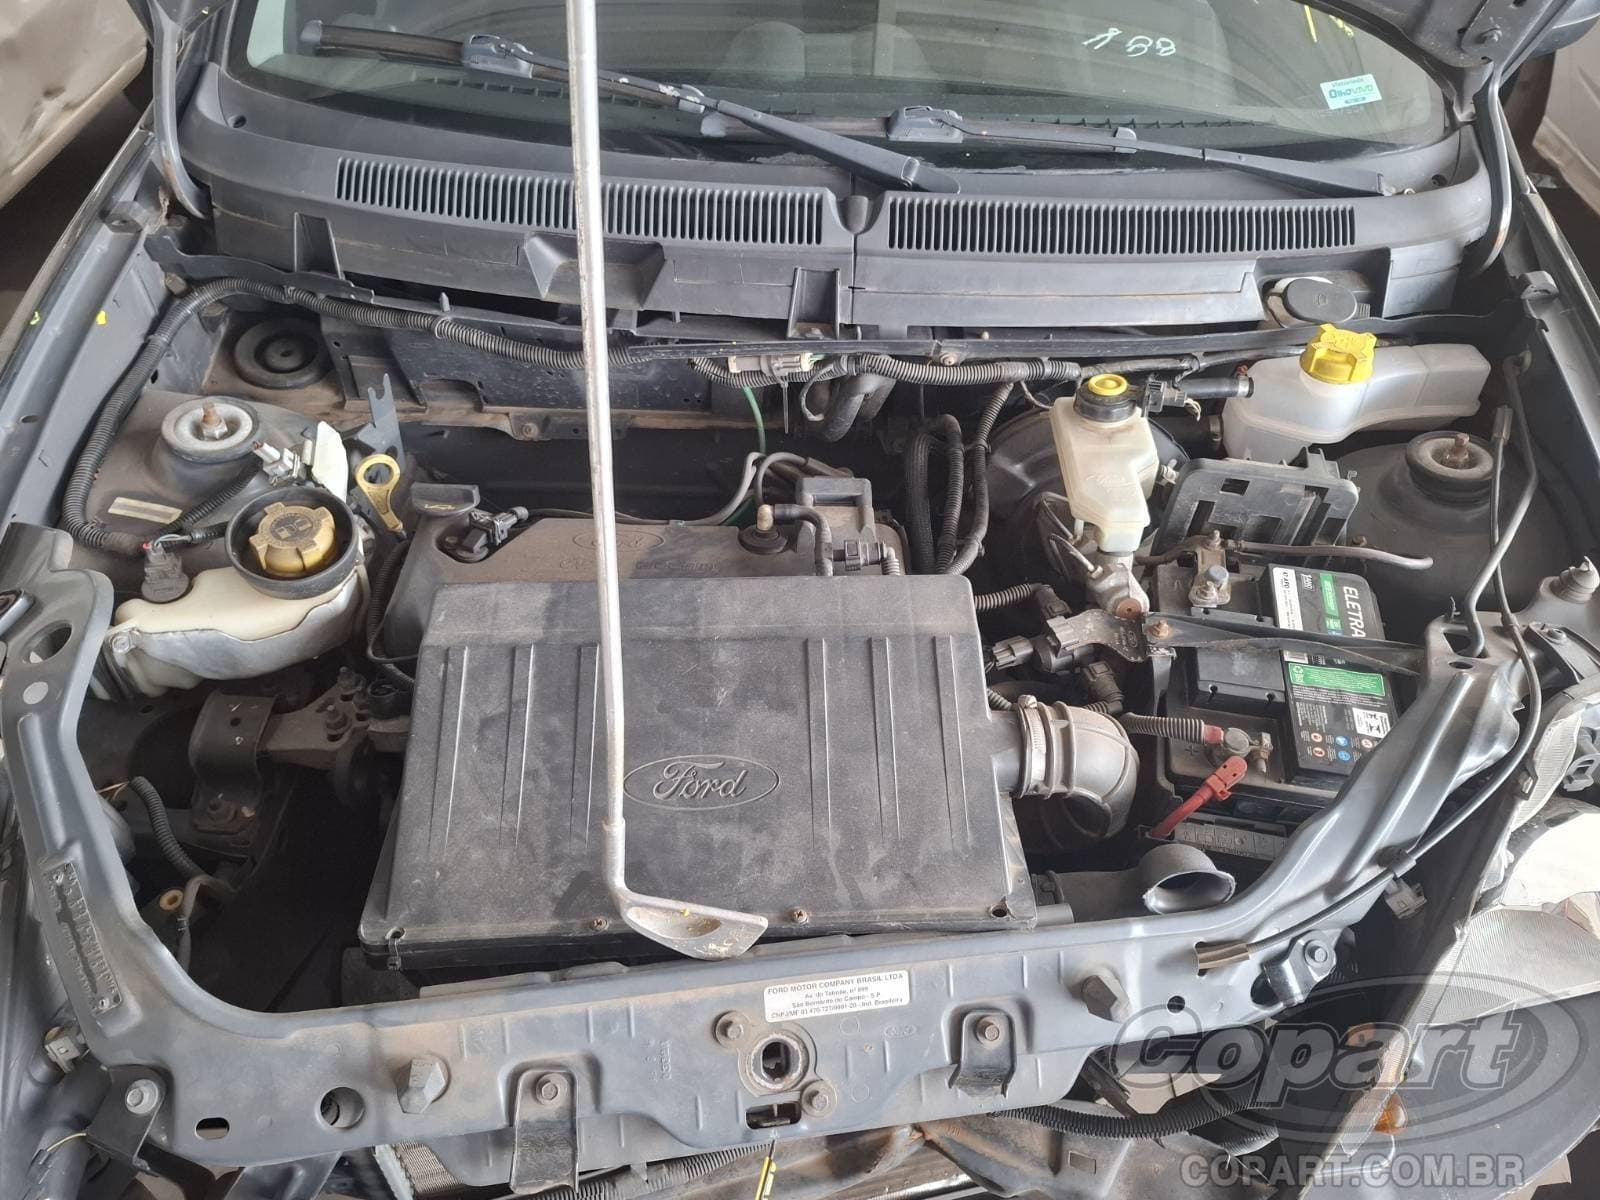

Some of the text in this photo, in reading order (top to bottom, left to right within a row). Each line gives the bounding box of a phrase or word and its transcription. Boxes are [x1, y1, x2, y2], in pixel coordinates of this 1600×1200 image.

[653, 761, 749, 799] Ford
[767, 986, 789, 995] FORD
[790, 983, 818, 992] MOTOR
[819, 979, 854, 989] COMPANY
[856, 975, 883, 984] BRASIL
